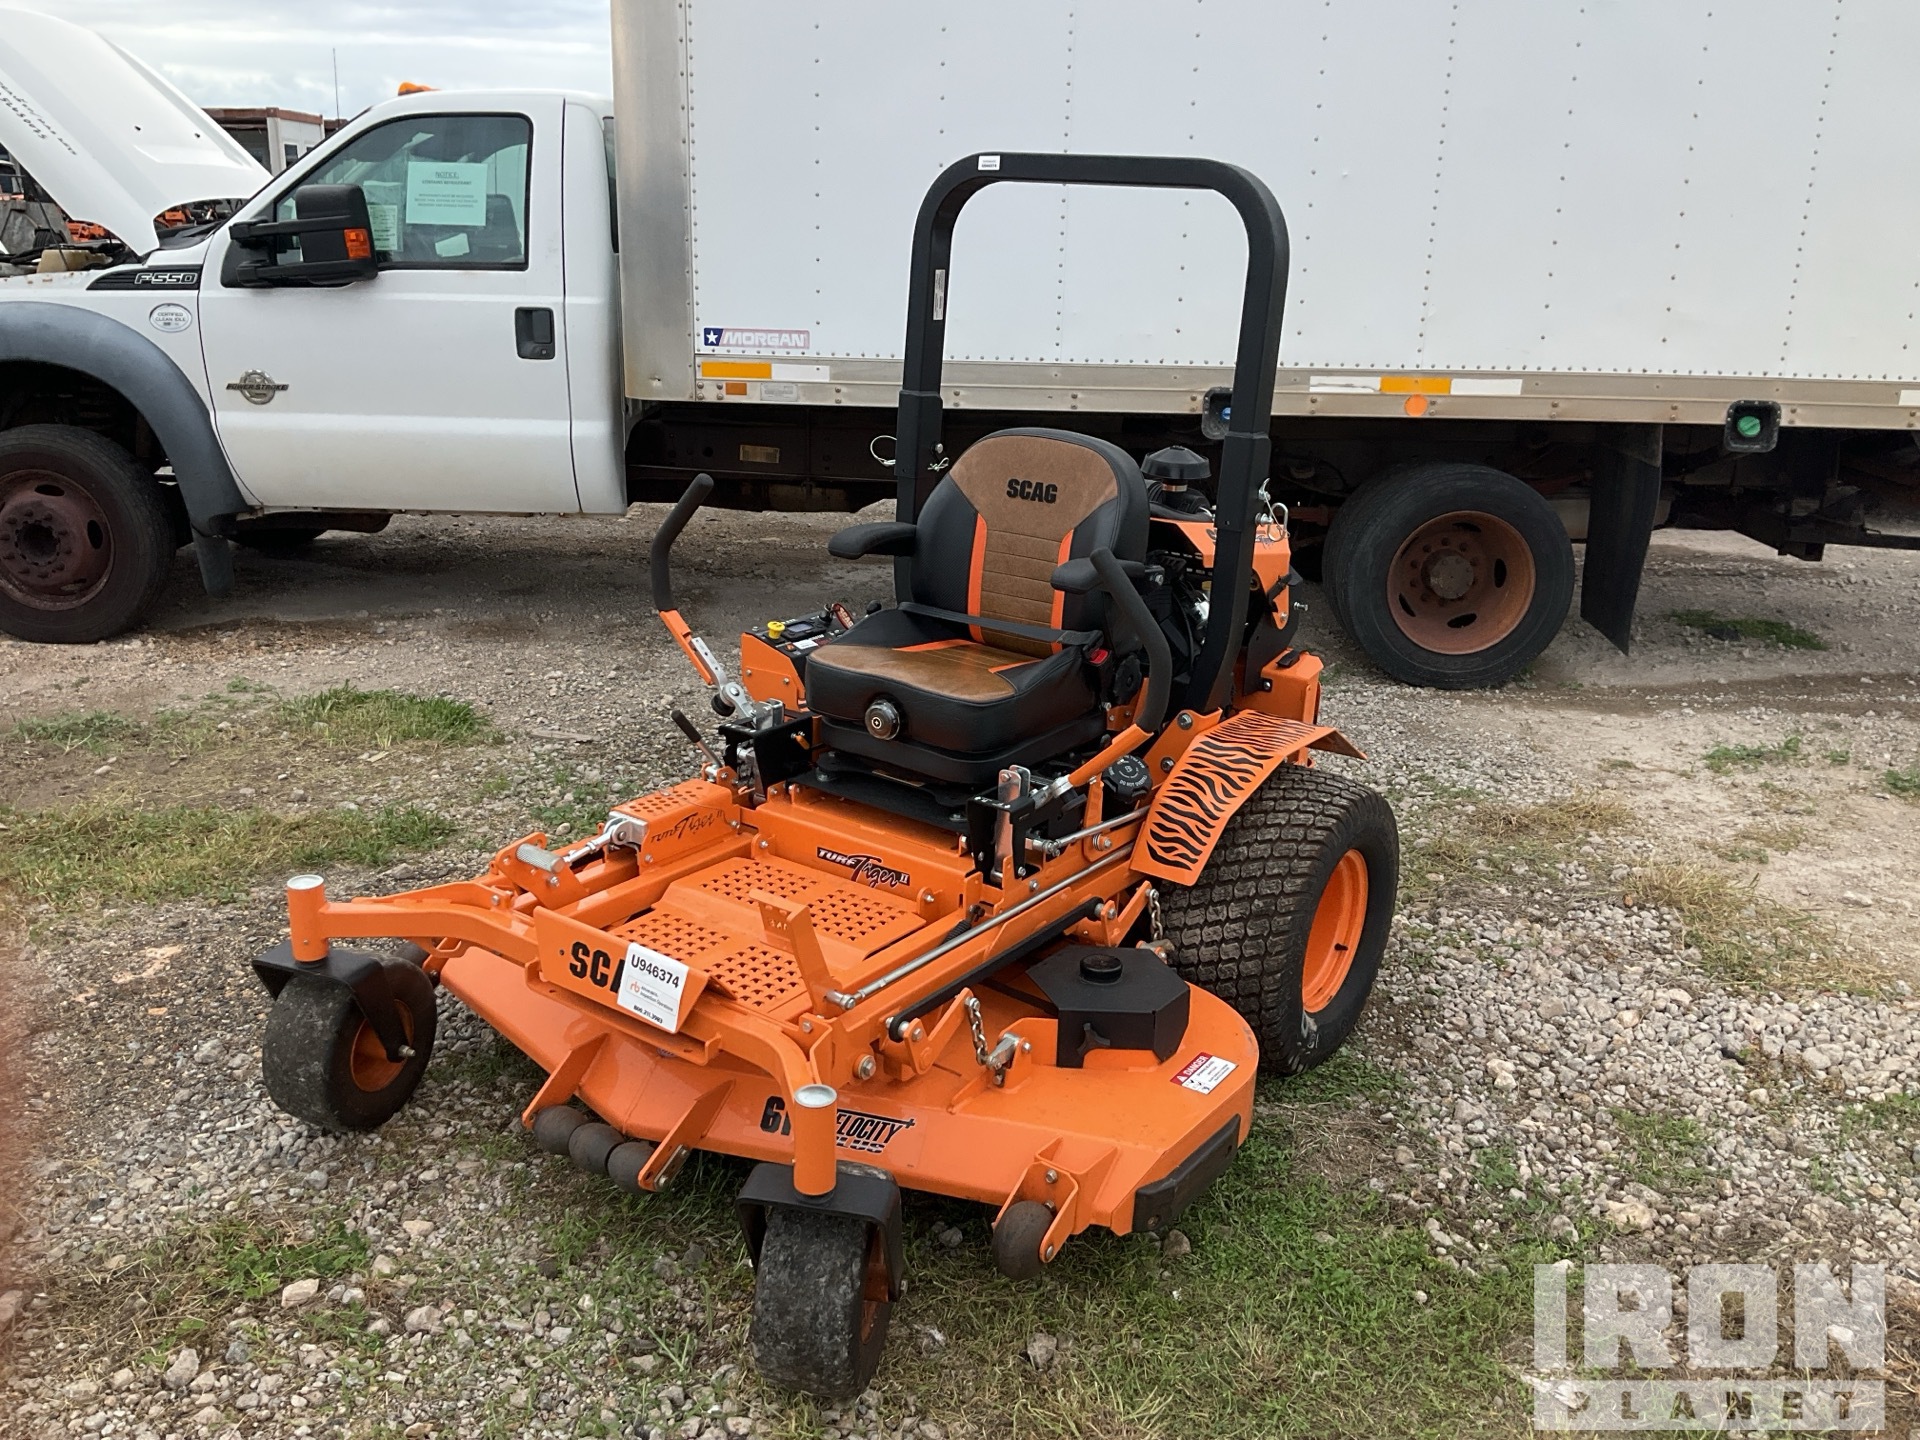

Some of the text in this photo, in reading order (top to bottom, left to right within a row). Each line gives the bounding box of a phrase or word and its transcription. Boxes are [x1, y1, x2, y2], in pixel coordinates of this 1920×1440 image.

[723, 331, 805, 347] MORGAN
[1006, 478, 1058, 504] SCAG
[818, 849, 857, 867] TURF
[847, 853, 900, 889] Tiger
[631, 953, 680, 988] U946374
[1182, 1055, 1209, 1076] DANGER
[837, 1136, 885, 1154] LUS
